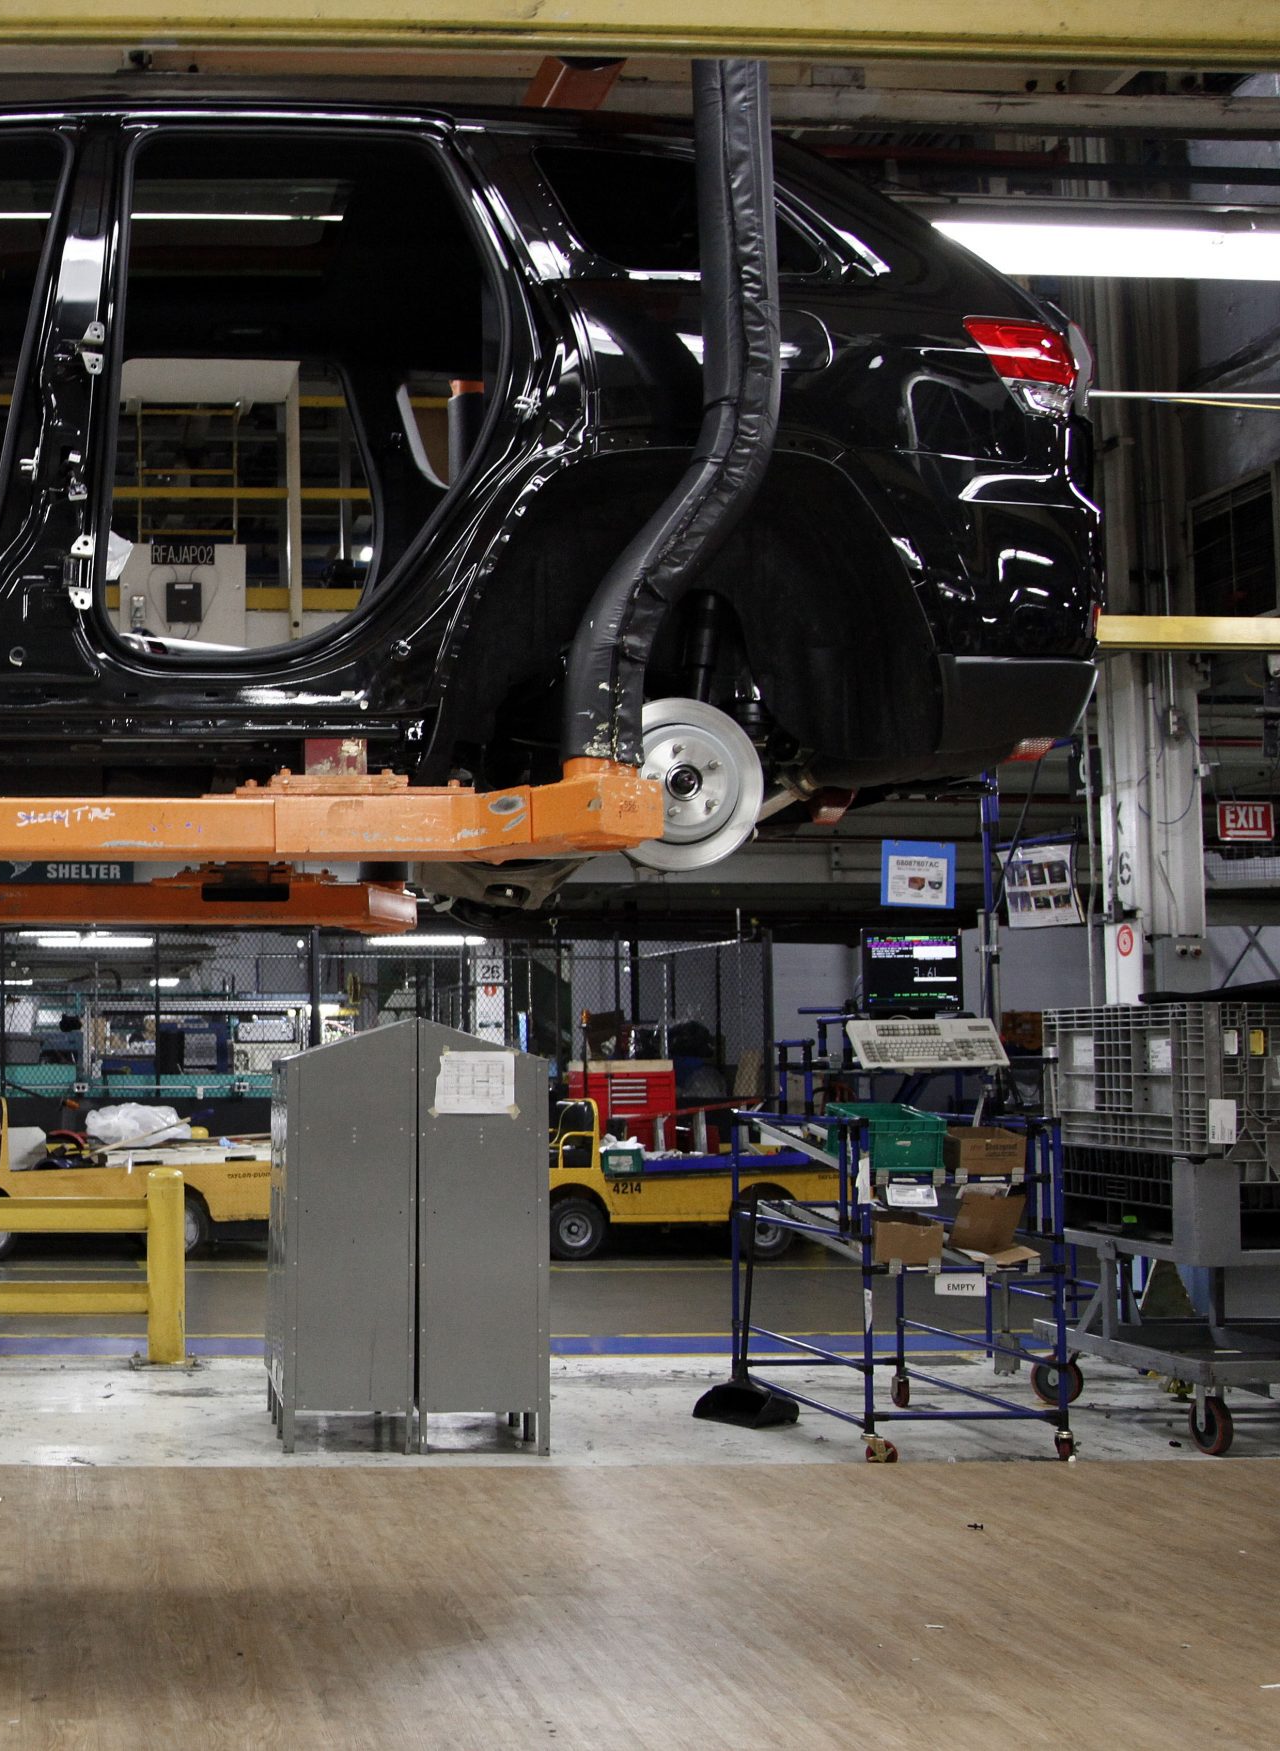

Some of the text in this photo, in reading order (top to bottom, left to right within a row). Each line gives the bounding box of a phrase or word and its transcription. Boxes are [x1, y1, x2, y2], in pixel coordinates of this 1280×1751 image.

[1225, 805, 1266, 829] EXIT
[46, 863, 122, 880] SHELTER
[481, 964, 501, 980] 26
[612, 1182, 642, 1195] 4214
[946, 1283, 976, 1292] EMPTY
